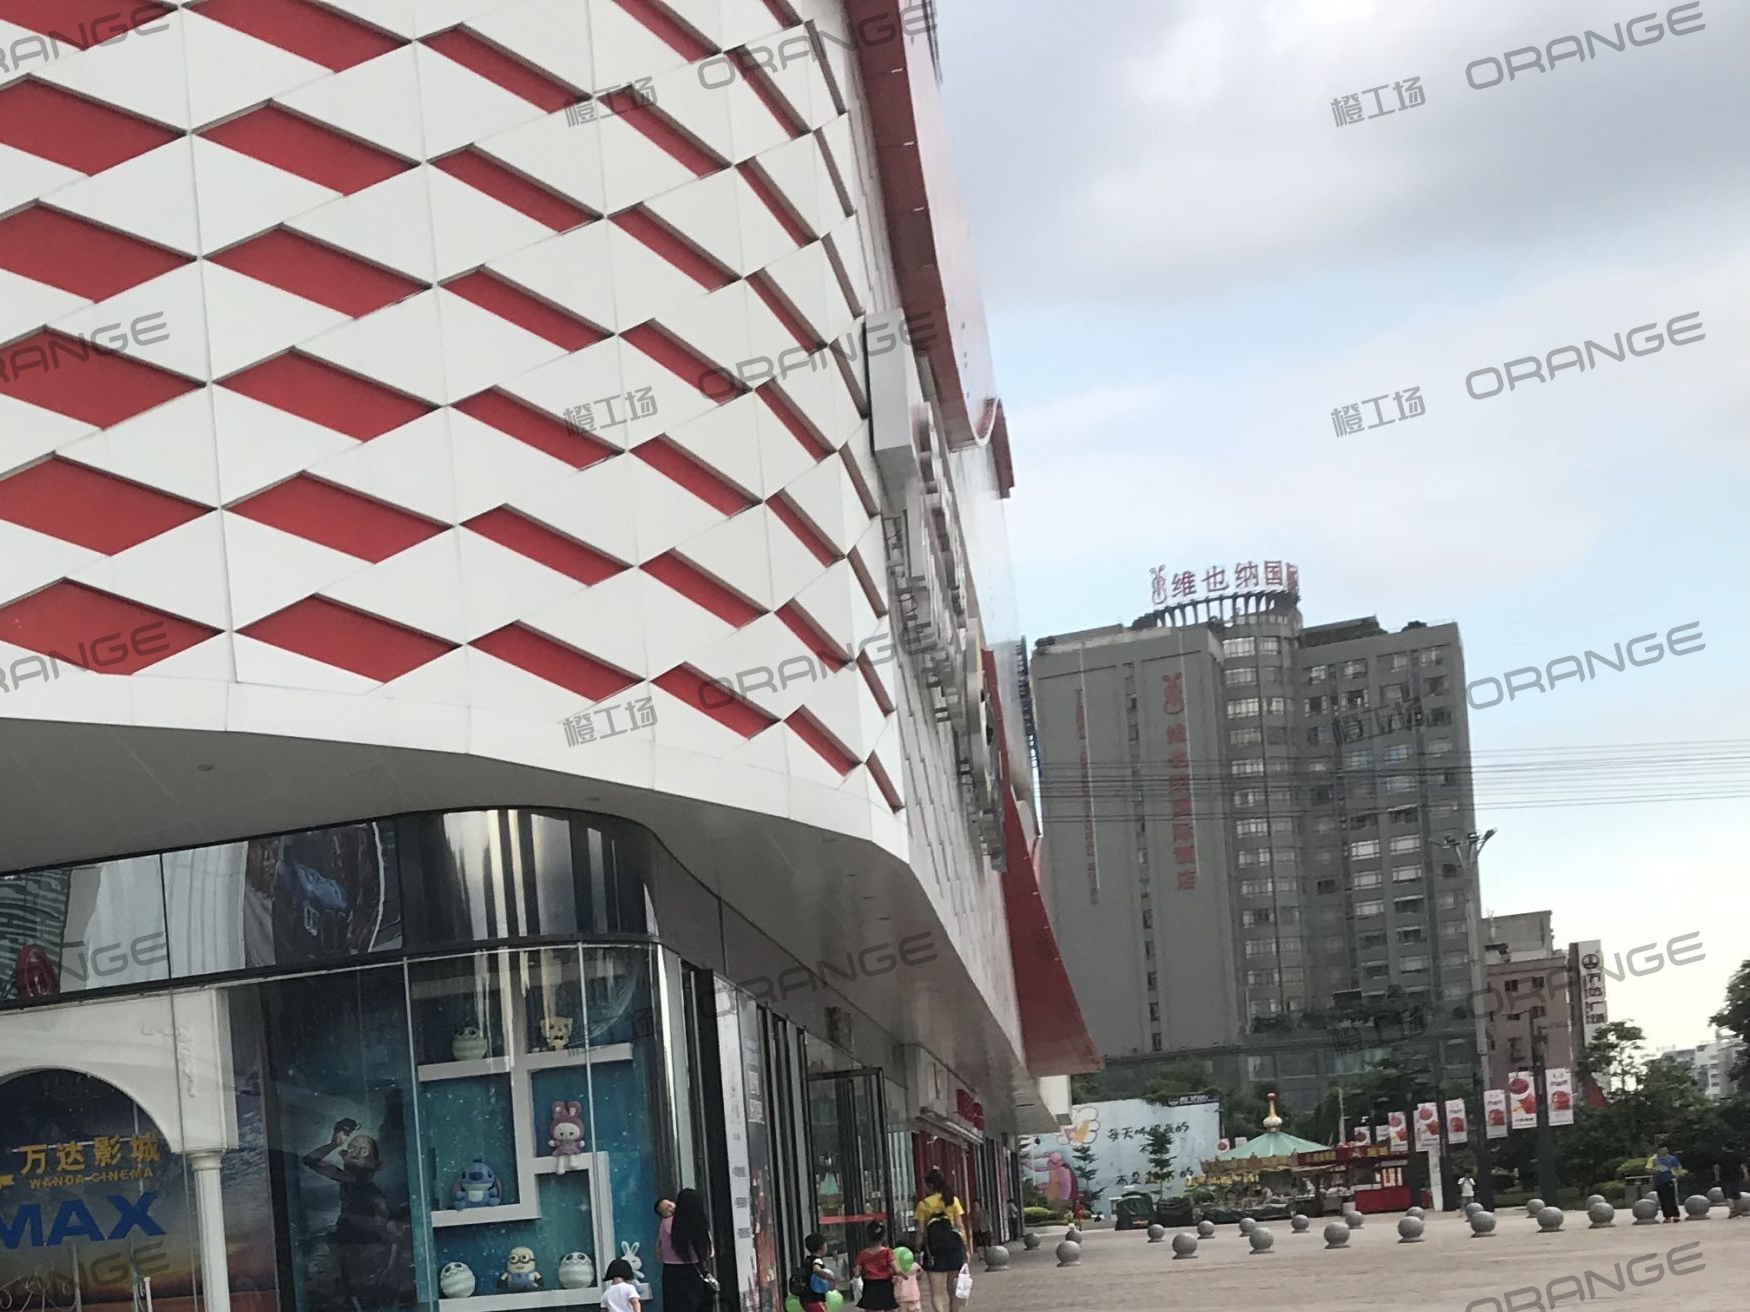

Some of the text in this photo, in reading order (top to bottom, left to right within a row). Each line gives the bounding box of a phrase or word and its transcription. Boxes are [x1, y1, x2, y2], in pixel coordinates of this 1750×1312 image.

[19, 1133, 161, 1175] 万达影城
[29, 1167, 154, 1190] WANDA CINEMA
